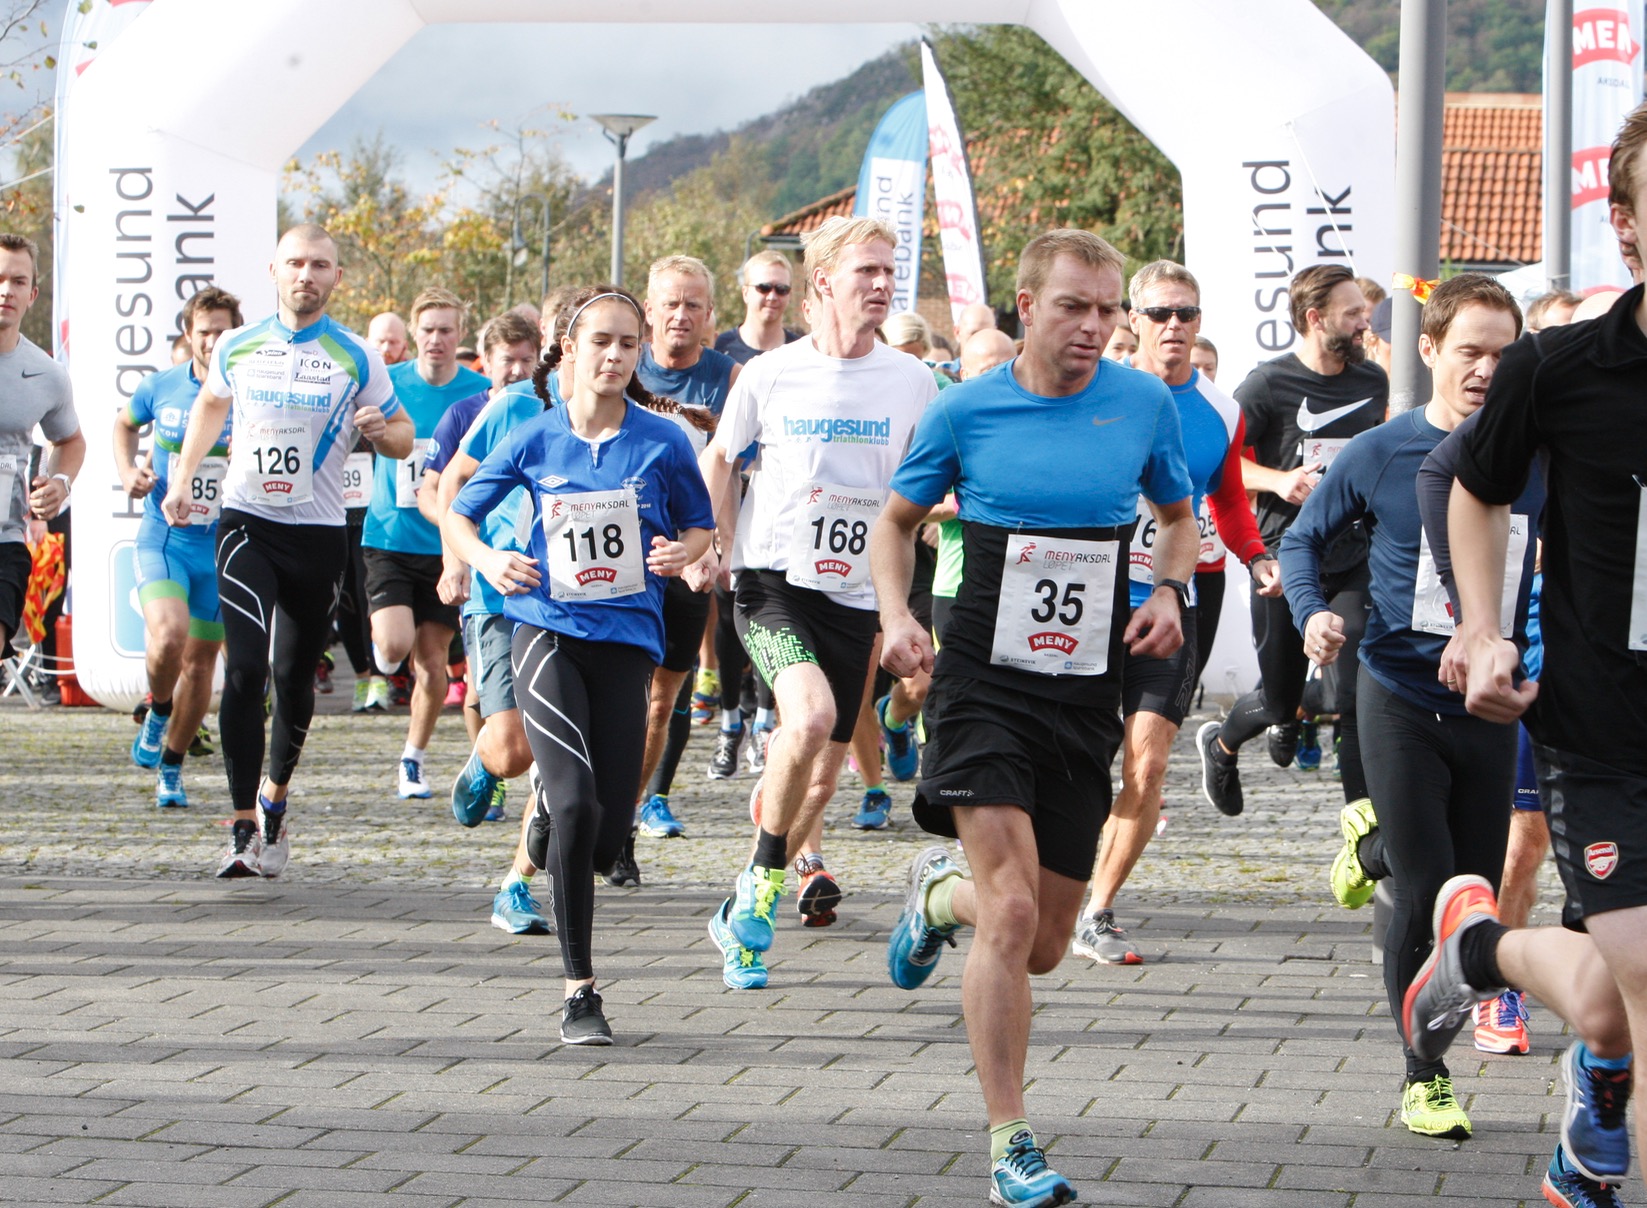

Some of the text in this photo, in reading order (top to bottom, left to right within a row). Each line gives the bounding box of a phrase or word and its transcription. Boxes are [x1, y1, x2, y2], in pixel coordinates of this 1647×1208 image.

[246, 386, 332, 408] haugesund
[783, 415, 891, 443] haugesund
[833, 434, 889, 446] triathlonklubb
[253, 445, 301, 475] 126
[265, 482, 291, 492] MENY
[571, 500, 630, 512] MENYAKSDAL
[828, 494, 881, 508] MENYAKSDAL
[563, 523, 625, 562] 118
[811, 516, 868, 556] 168
[1044, 550, 1112, 564] MENYAKSDAL
[818, 561, 850, 574] MENY
[1043, 560, 1075, 571] LØPET
[579, 570, 613, 583] MENY
[1031, 578, 1087, 627] 35
[1033, 635, 1075, 650] MENY
[939, 789, 968, 797] CRAFT
